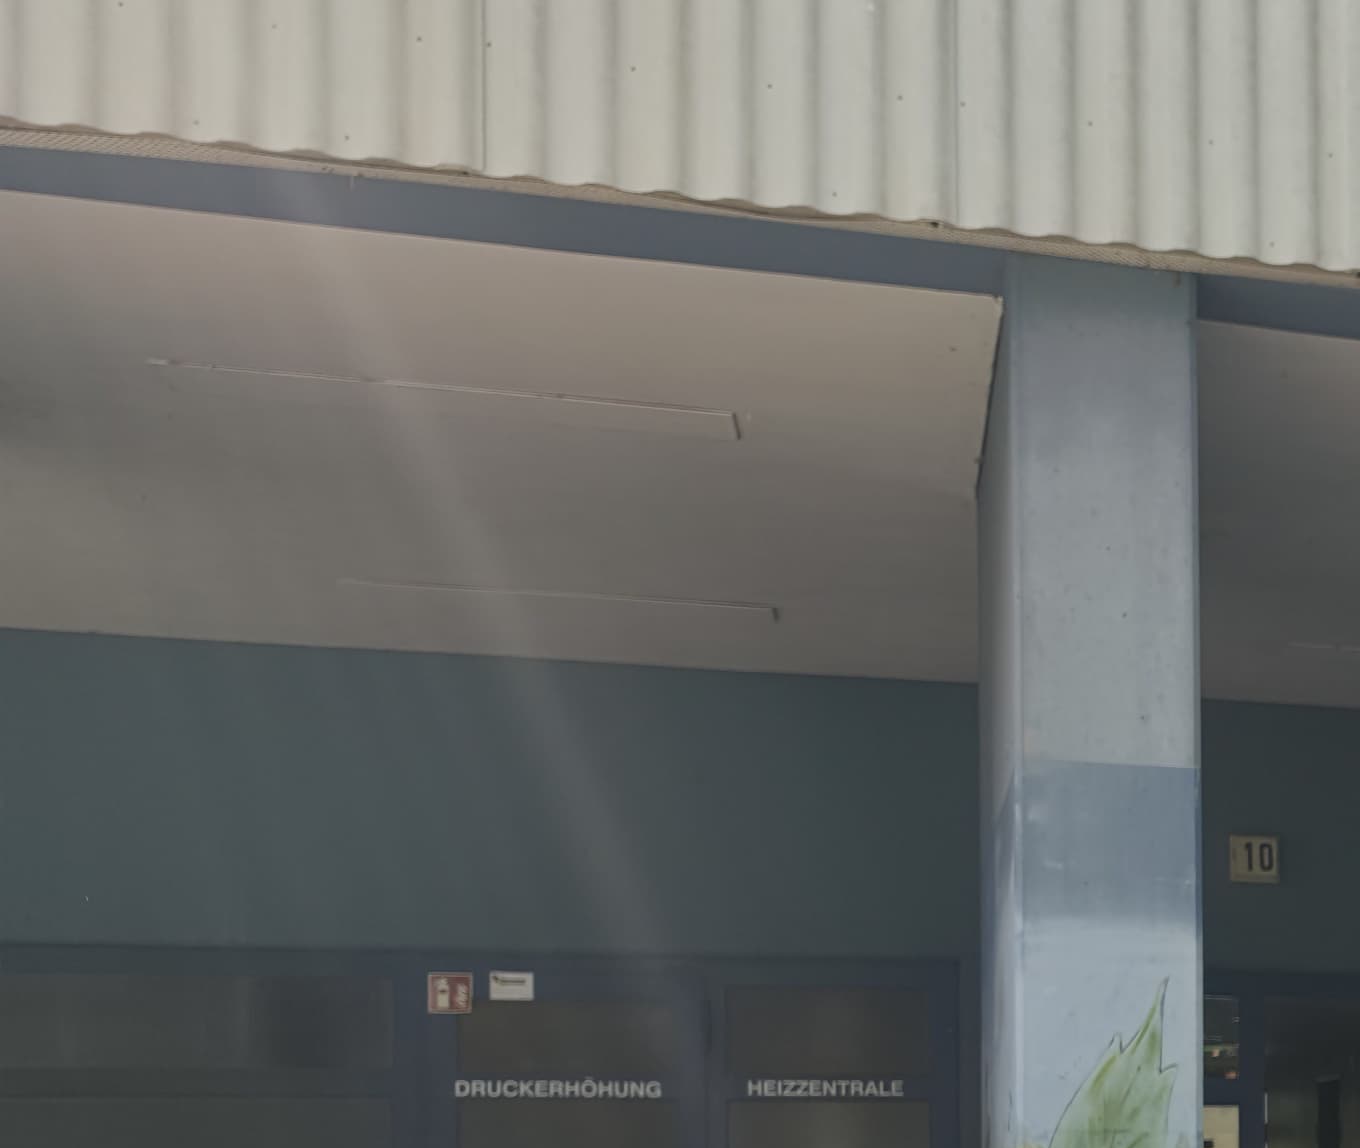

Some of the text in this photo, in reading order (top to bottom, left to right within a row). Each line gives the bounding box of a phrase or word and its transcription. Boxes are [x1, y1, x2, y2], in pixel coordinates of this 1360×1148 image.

[1244, 841, 1274, 873] 10
[454, 1076, 663, 1099] DRUCKERHÖHUNG
[747, 1078, 905, 1097] HEIZZENTRALE
